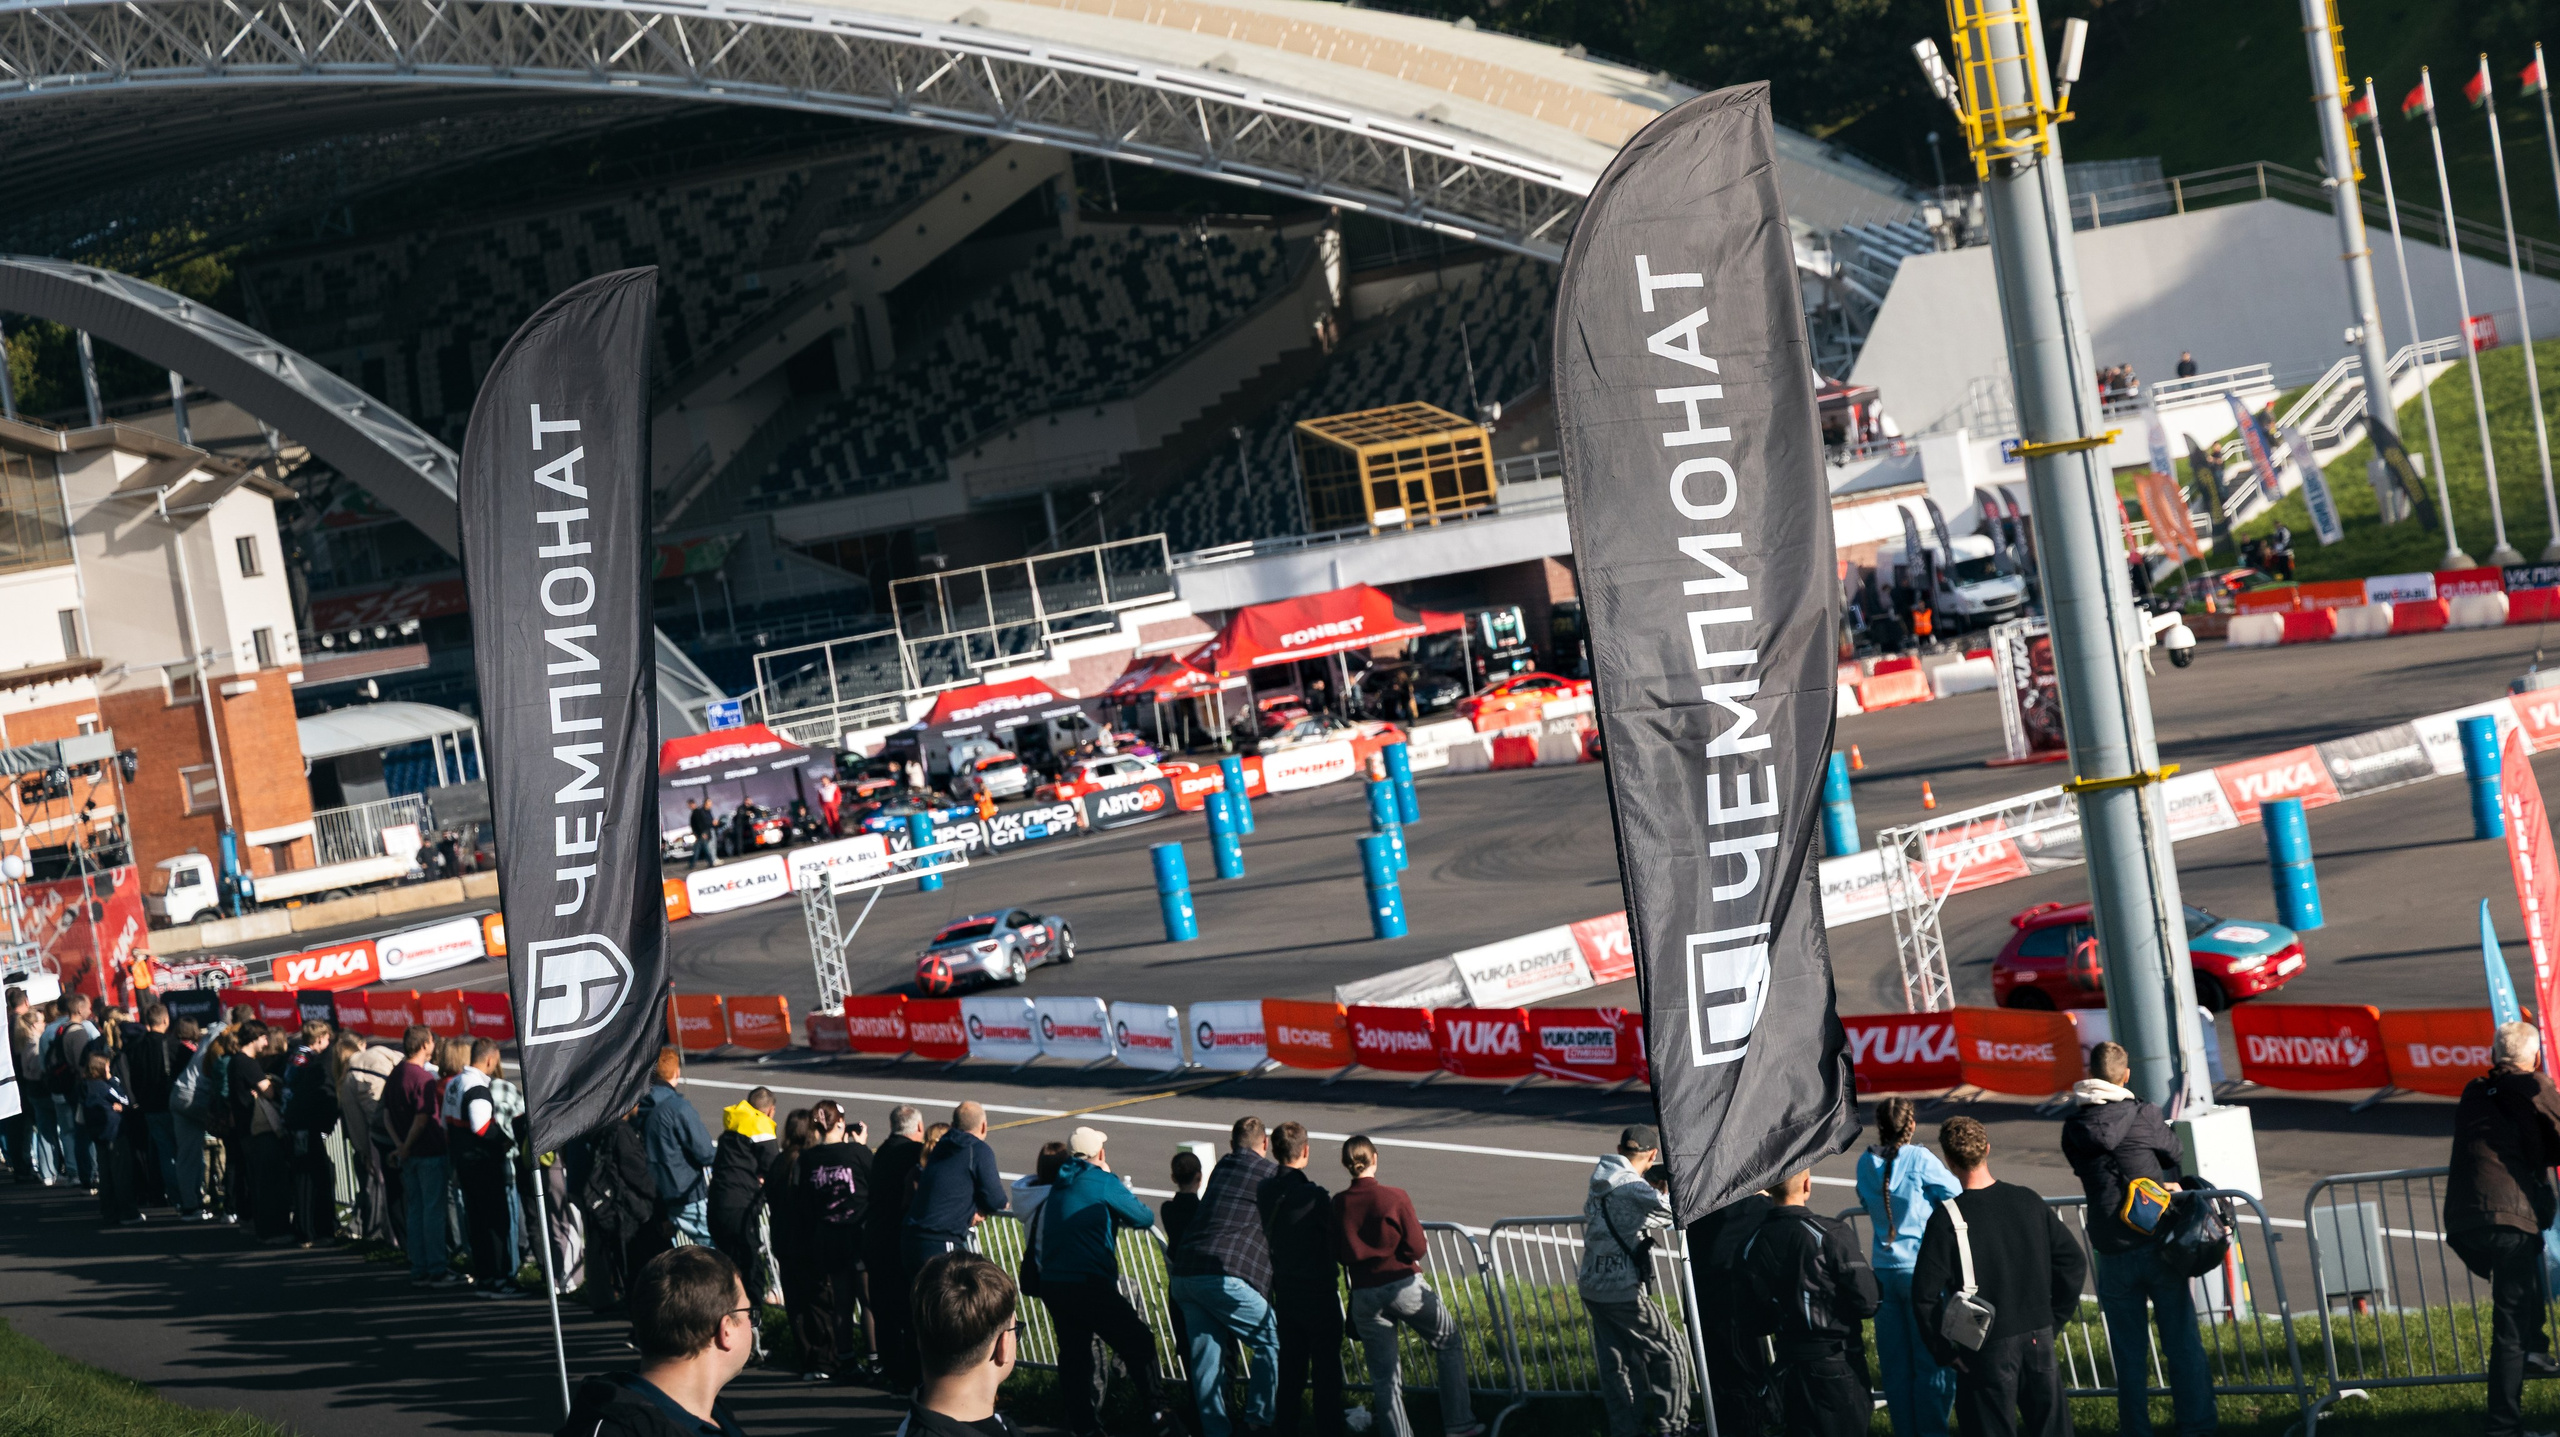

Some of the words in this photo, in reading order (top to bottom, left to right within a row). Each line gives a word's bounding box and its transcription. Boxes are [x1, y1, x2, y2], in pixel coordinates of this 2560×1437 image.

[1634, 253, 1781, 904] ЧЕМПИОНАТ
[1280, 616, 1364, 648] FONBET
[530, 403, 603, 917] ЧЕМПИОНАТ
[2235, 762, 2317, 801] YUKA
[988, 813, 1020, 831] VK
[1023, 803, 1074, 826] ПРО
[991, 817, 1077, 846] СПОРТ
[1820, 880, 1853, 896] UKA
[1593, 930, 1632, 960] YU
[287, 949, 369, 984] YUKA
[1471, 963, 1516, 984] YUKA
[1520, 948, 1572, 972] DRIVE
[1290, 1027, 1334, 1049] CORE
[1446, 1020, 1521, 1055] YUKA
[1543, 1031, 1575, 1047] YUKA
[1577, 1031, 1612, 1046] DRIVE
[1847, 1024, 1960, 1065] YUKA
[1992, 1042, 2056, 1062] CORE
[2246, 1034, 2341, 1066] DRYDRY
[2431, 1045, 2493, 1067] COR
